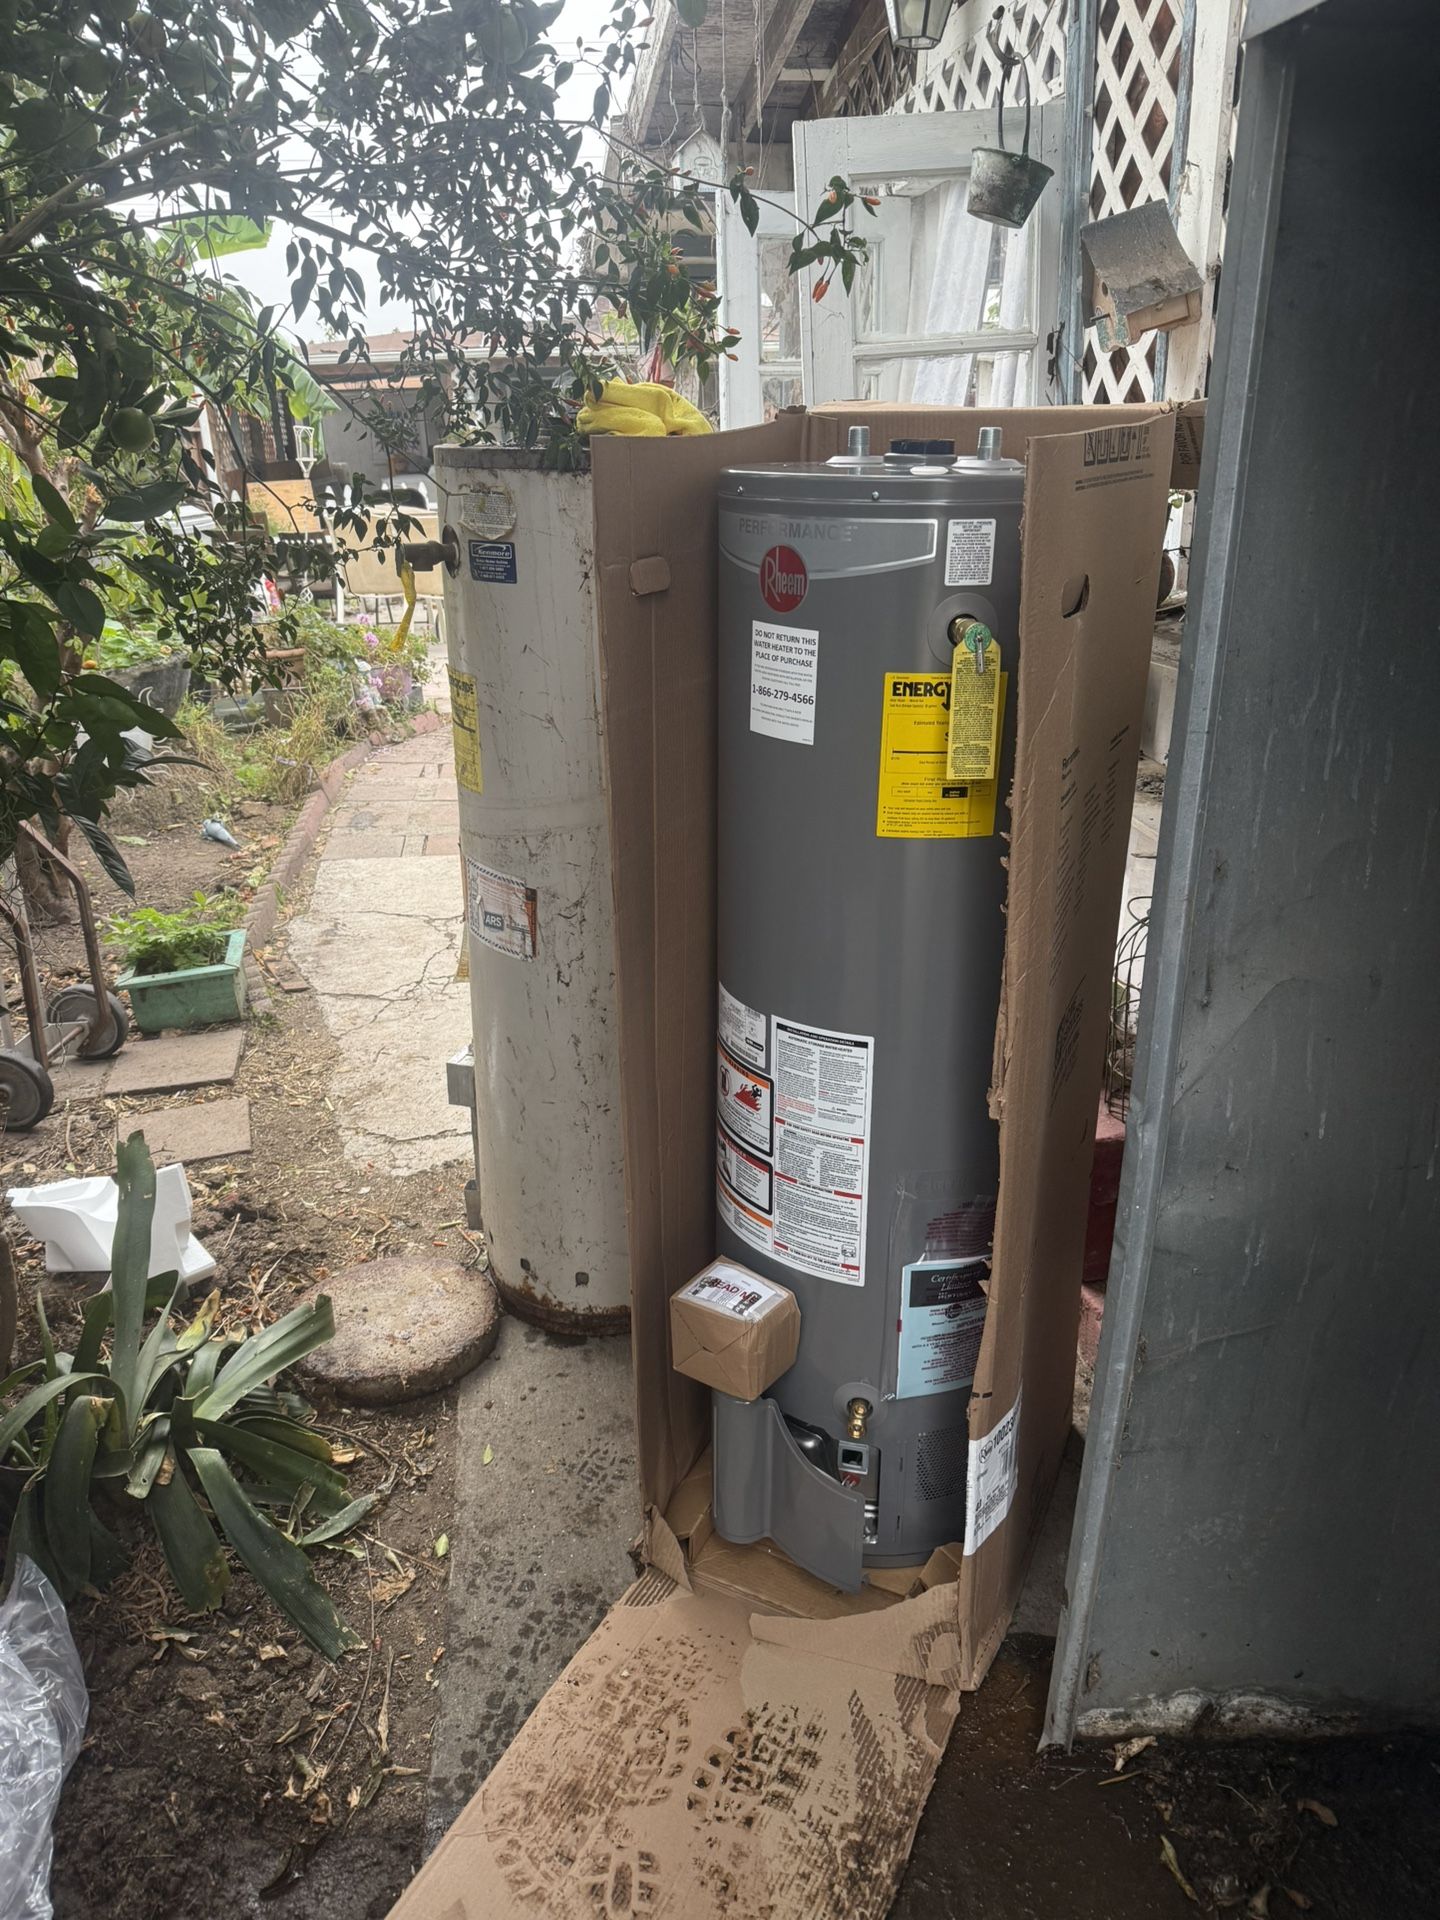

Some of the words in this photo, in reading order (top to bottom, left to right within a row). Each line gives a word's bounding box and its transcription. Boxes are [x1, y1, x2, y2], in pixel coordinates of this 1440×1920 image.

[739, 518, 852, 541] PERFORMANCE
[765, 547, 804, 602] Rheem
[755, 629, 762, 637] DO
[764, 631, 775, 639] NOT
[776, 634, 800, 644] RETURN
[801, 637, 816, 646] THIS
[754, 640, 770, 649] WATER
[772, 644, 793, 653] HEATER
[794, 647, 803, 655] TO
[804, 649, 816, 657] THE
[755, 651, 770, 660] PLACE
[780, 656, 813, 668] PURCHASE
[752, 684, 814, 705] 1-866-279-4566
[485, 914, 502, 927] ARS
